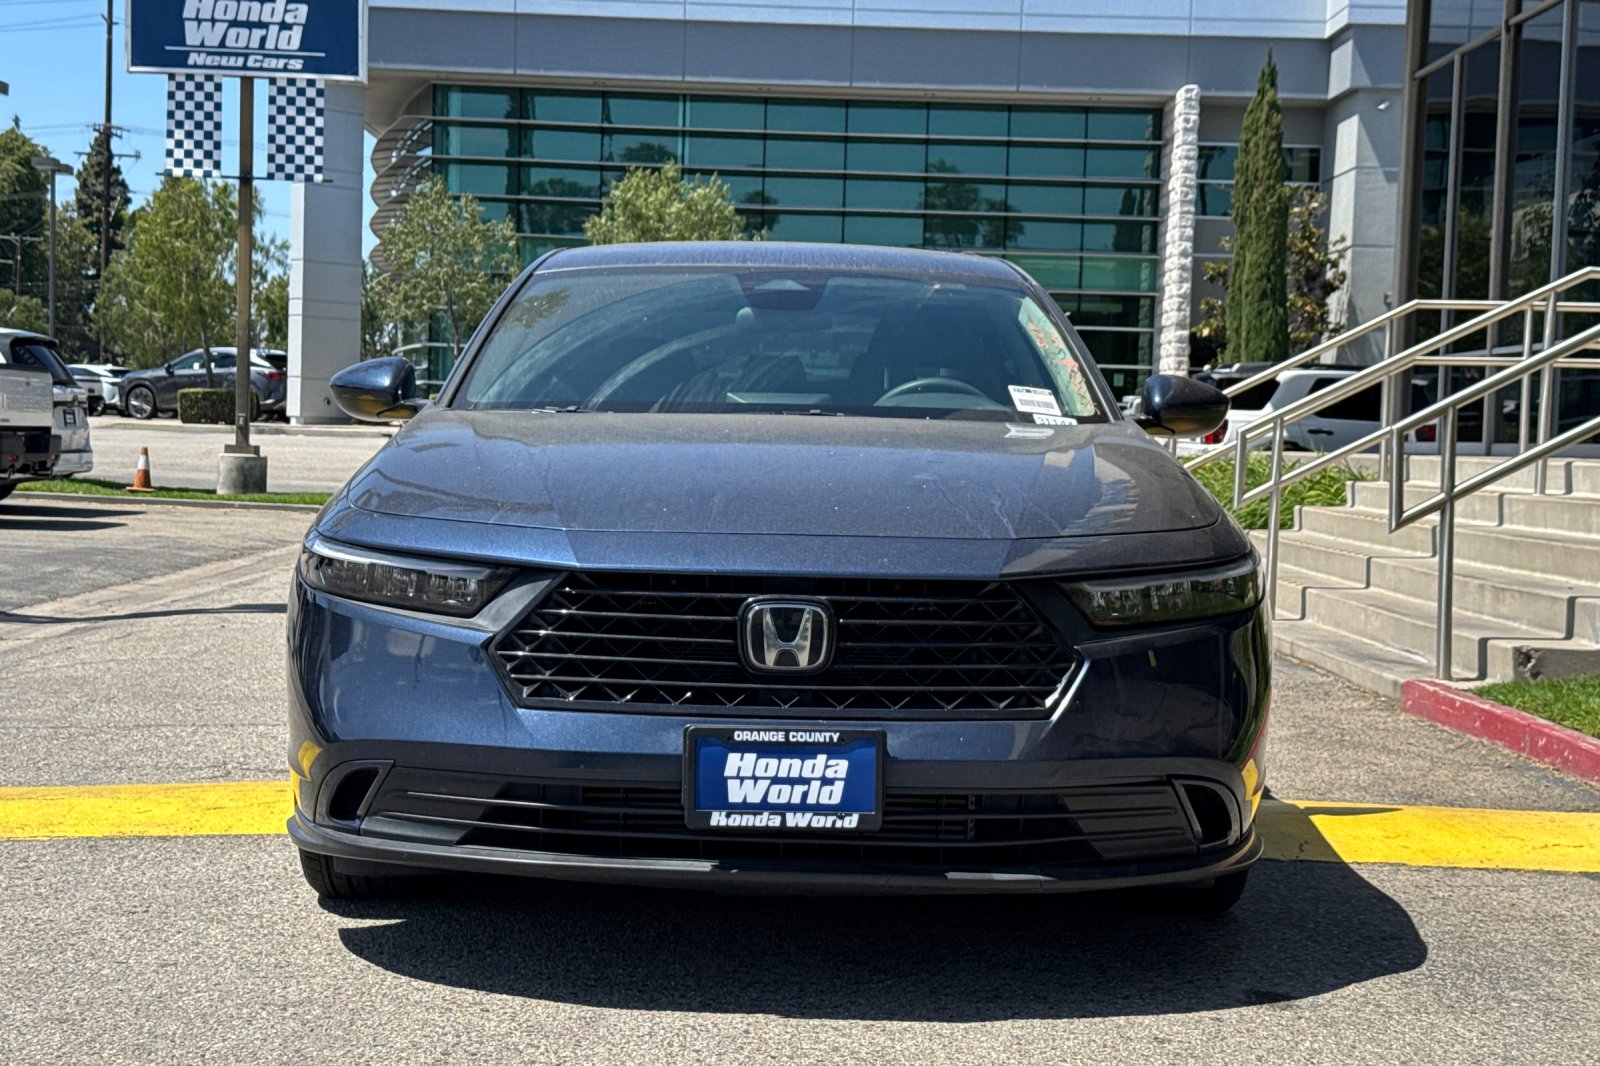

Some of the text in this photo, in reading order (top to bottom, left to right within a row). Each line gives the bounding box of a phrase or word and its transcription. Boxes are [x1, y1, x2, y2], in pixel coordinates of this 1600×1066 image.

[182, 0, 308, 25] Honda
[184, 20, 304, 51] World
[187, 52, 304, 70] New Cars
[733, 730, 840, 743] ORANGE COUNTY
[724, 752, 849, 779] Honda
[727, 779, 845, 805] World
[710, 811, 859, 829] Honda World
